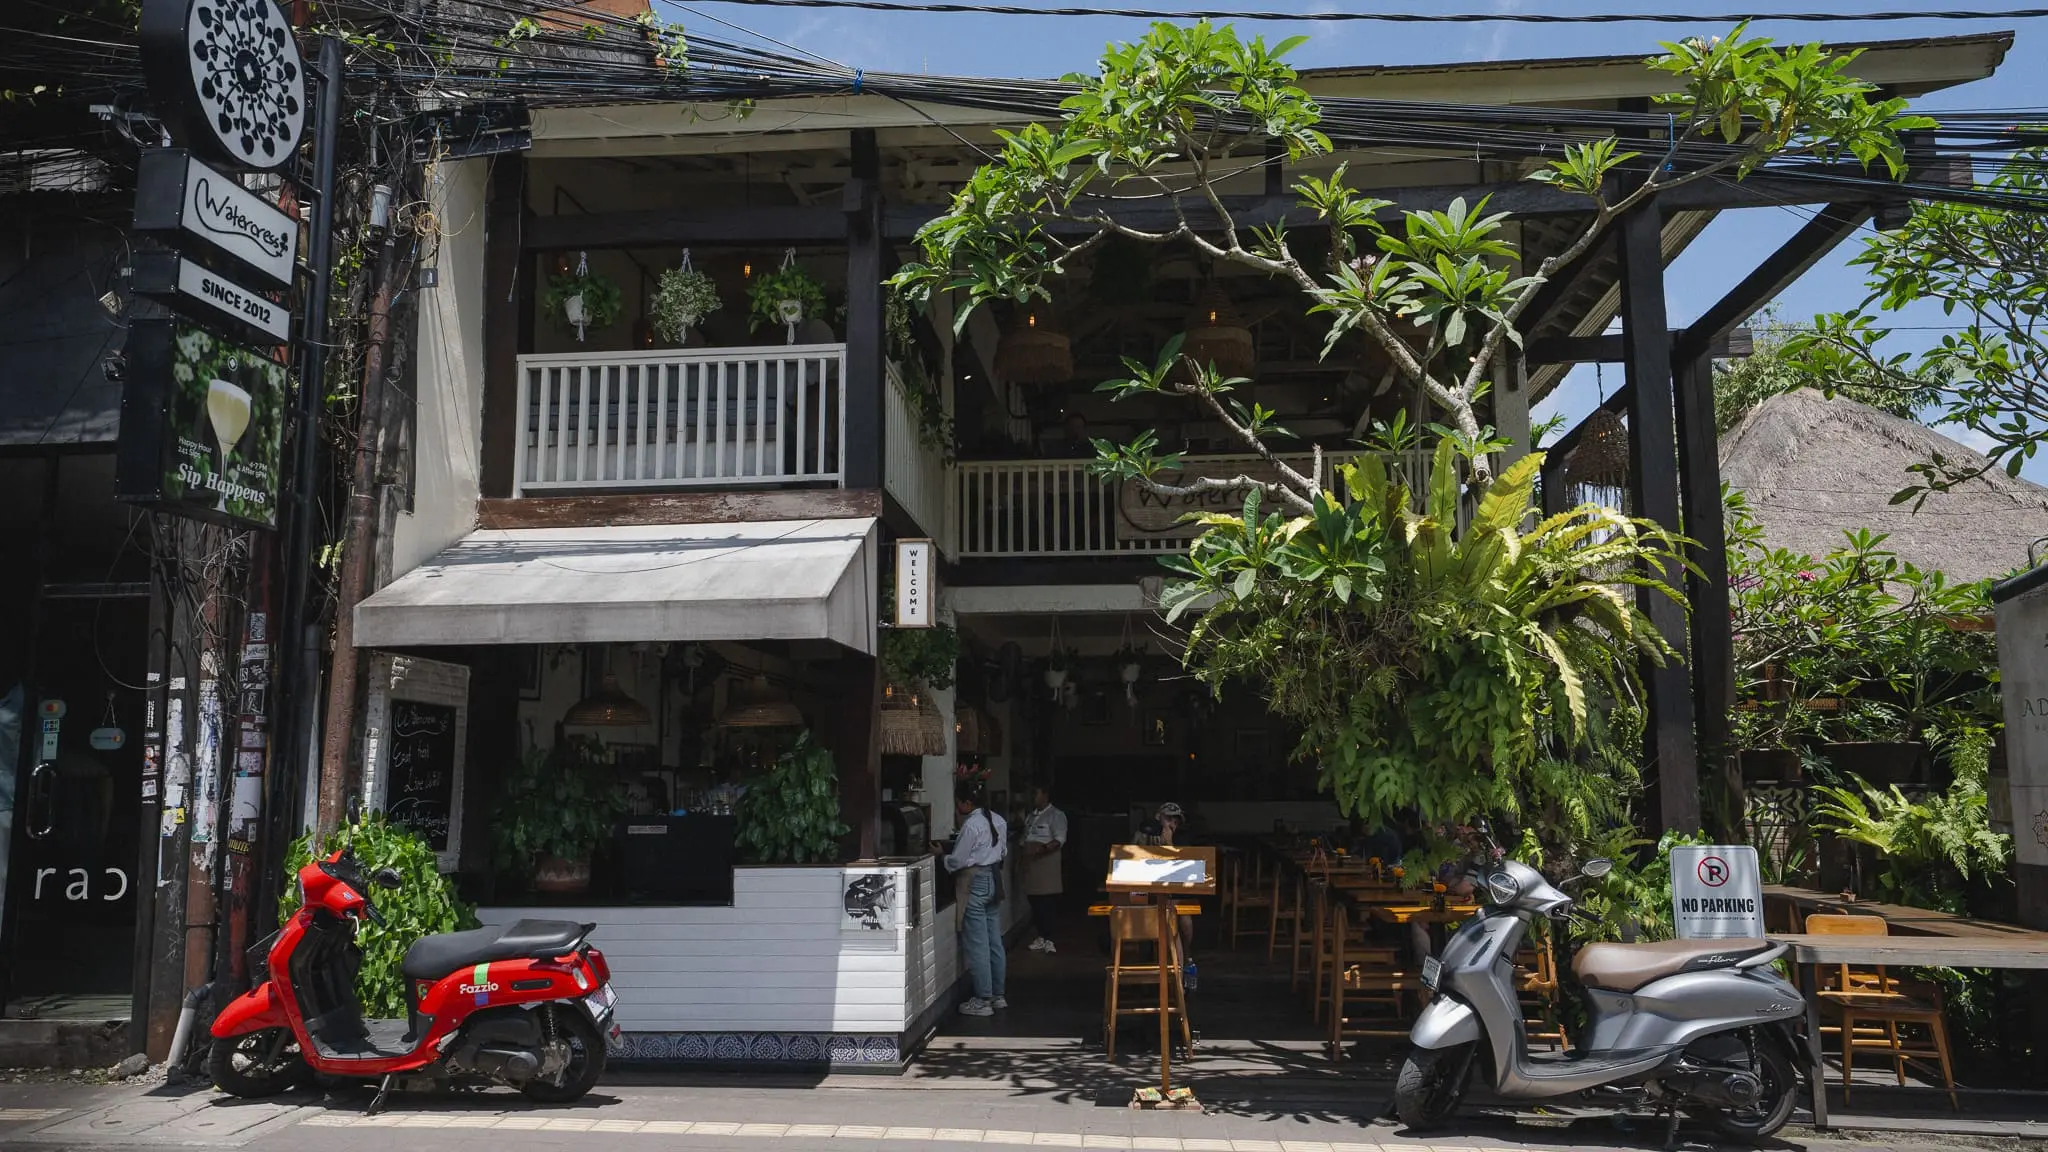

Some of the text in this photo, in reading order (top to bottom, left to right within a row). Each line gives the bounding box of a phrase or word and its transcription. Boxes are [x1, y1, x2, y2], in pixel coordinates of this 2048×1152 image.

[195, 178, 288, 256] Watercress
[202, 278, 271, 324] SINCE 2012
[179, 435, 197, 450] Happy
[177, 463, 266, 504] Sip Happens
[909, 550, 918, 615] WELCOME
[1681, 897, 1755, 913] NO PARKING
[460, 981, 499, 994] Fazzio
